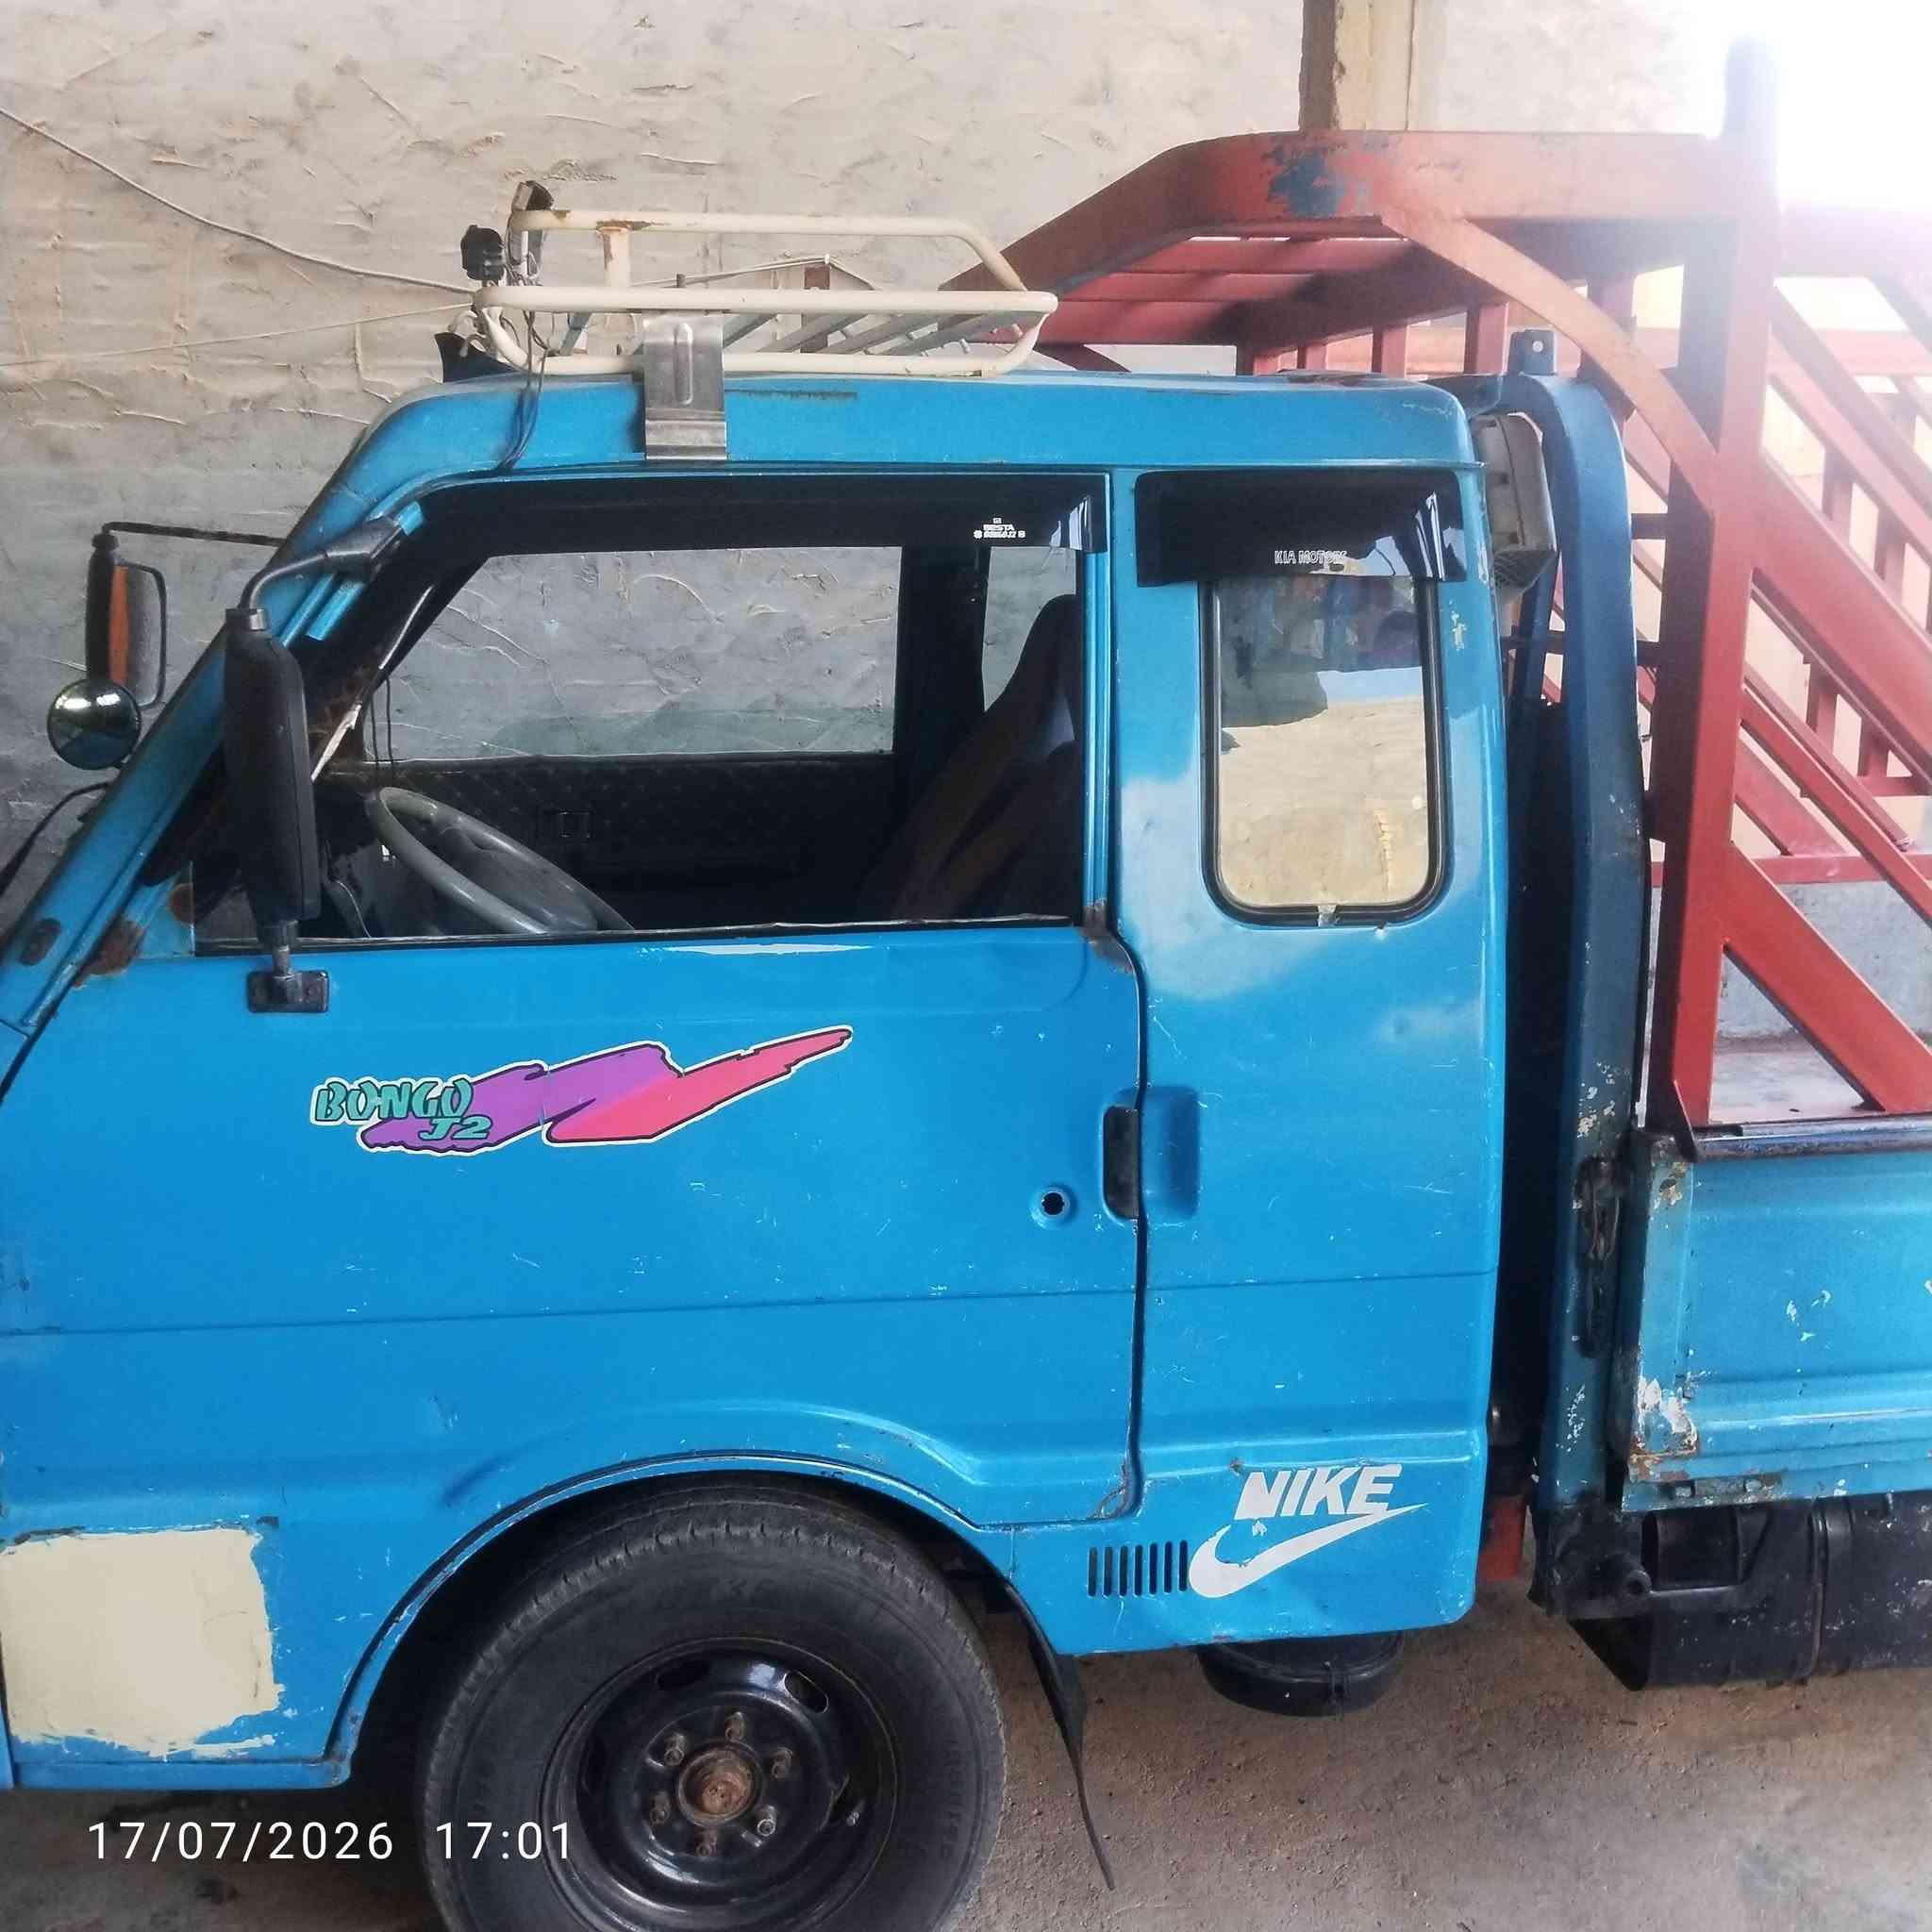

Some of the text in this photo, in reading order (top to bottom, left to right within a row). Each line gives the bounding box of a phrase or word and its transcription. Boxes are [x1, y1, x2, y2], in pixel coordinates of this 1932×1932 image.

[1274, 550, 1297, 564] KIA
[315, 1077, 474, 1122] BONGO
[418, 1114, 493, 1141] J2
[1234, 1463, 1403, 1521] NIKE
